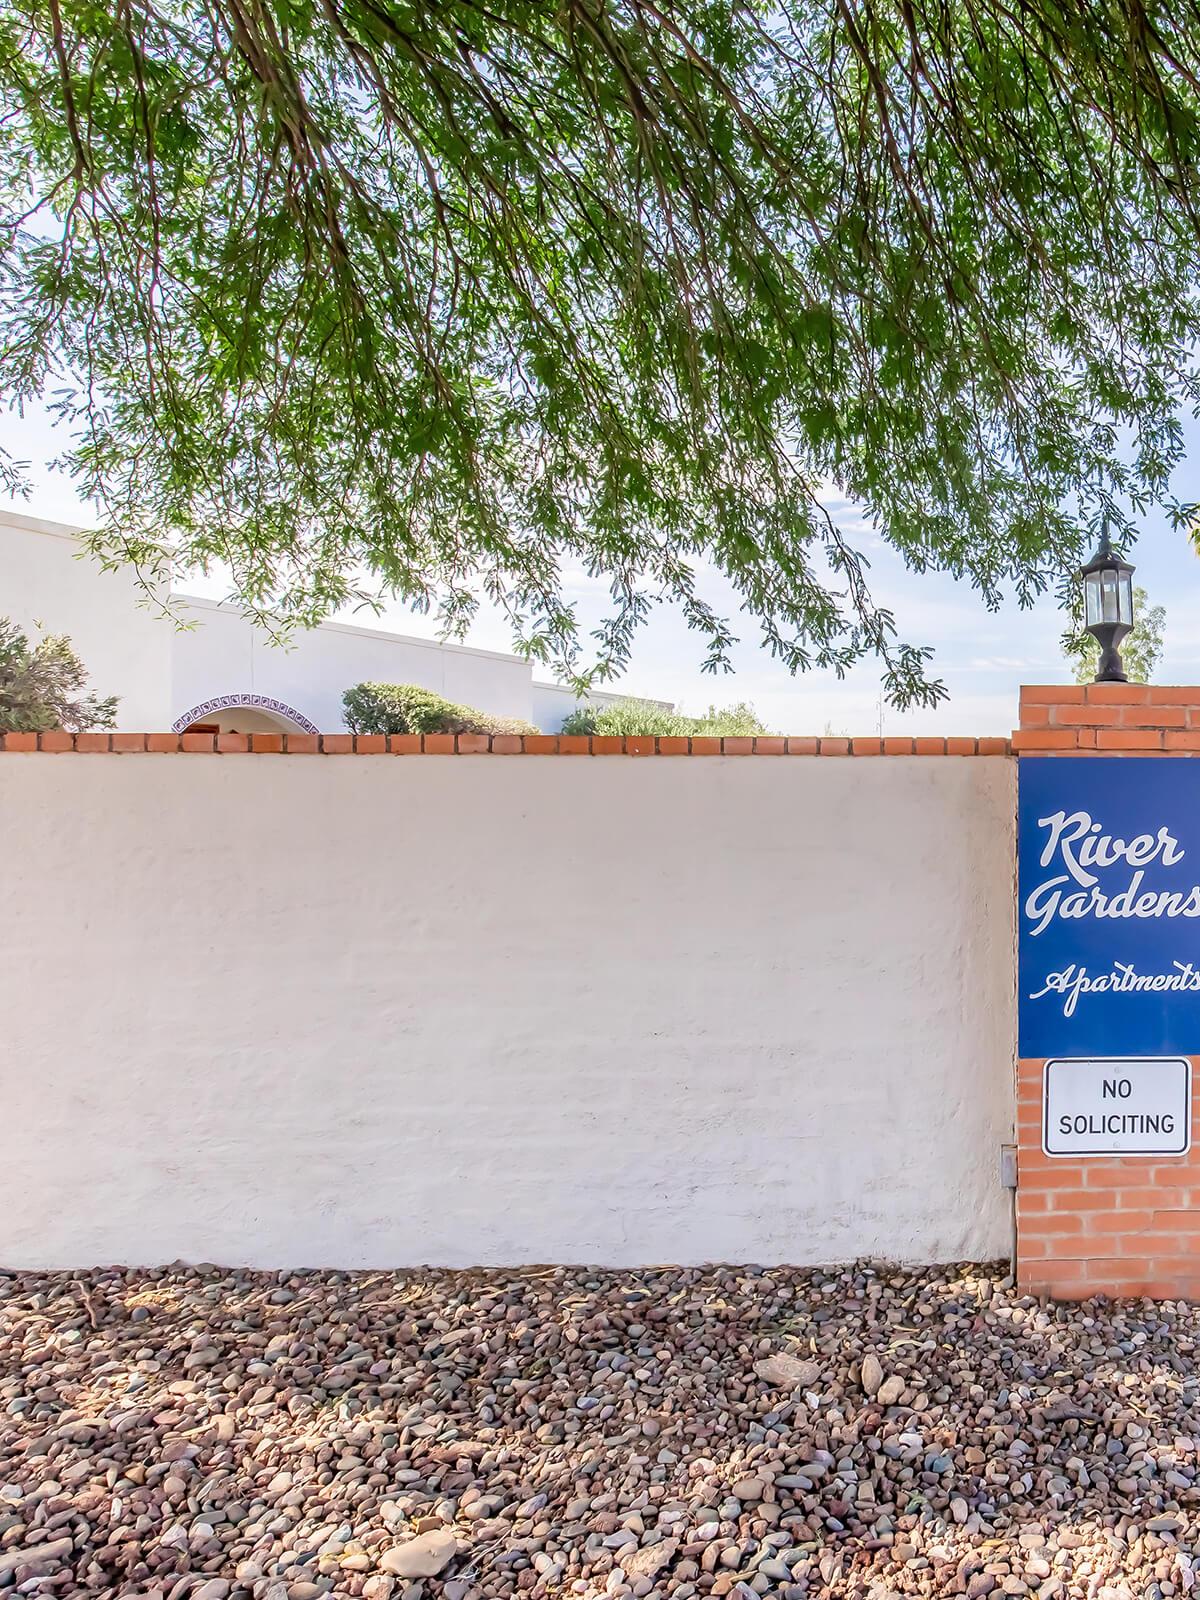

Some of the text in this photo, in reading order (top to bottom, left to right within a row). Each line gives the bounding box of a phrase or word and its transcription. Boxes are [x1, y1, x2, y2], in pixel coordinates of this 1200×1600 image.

[1038, 810, 1185, 887] River
[1102, 1080, 1131, 1099] NO
[1060, 1115, 1174, 1135] SOLICITING
